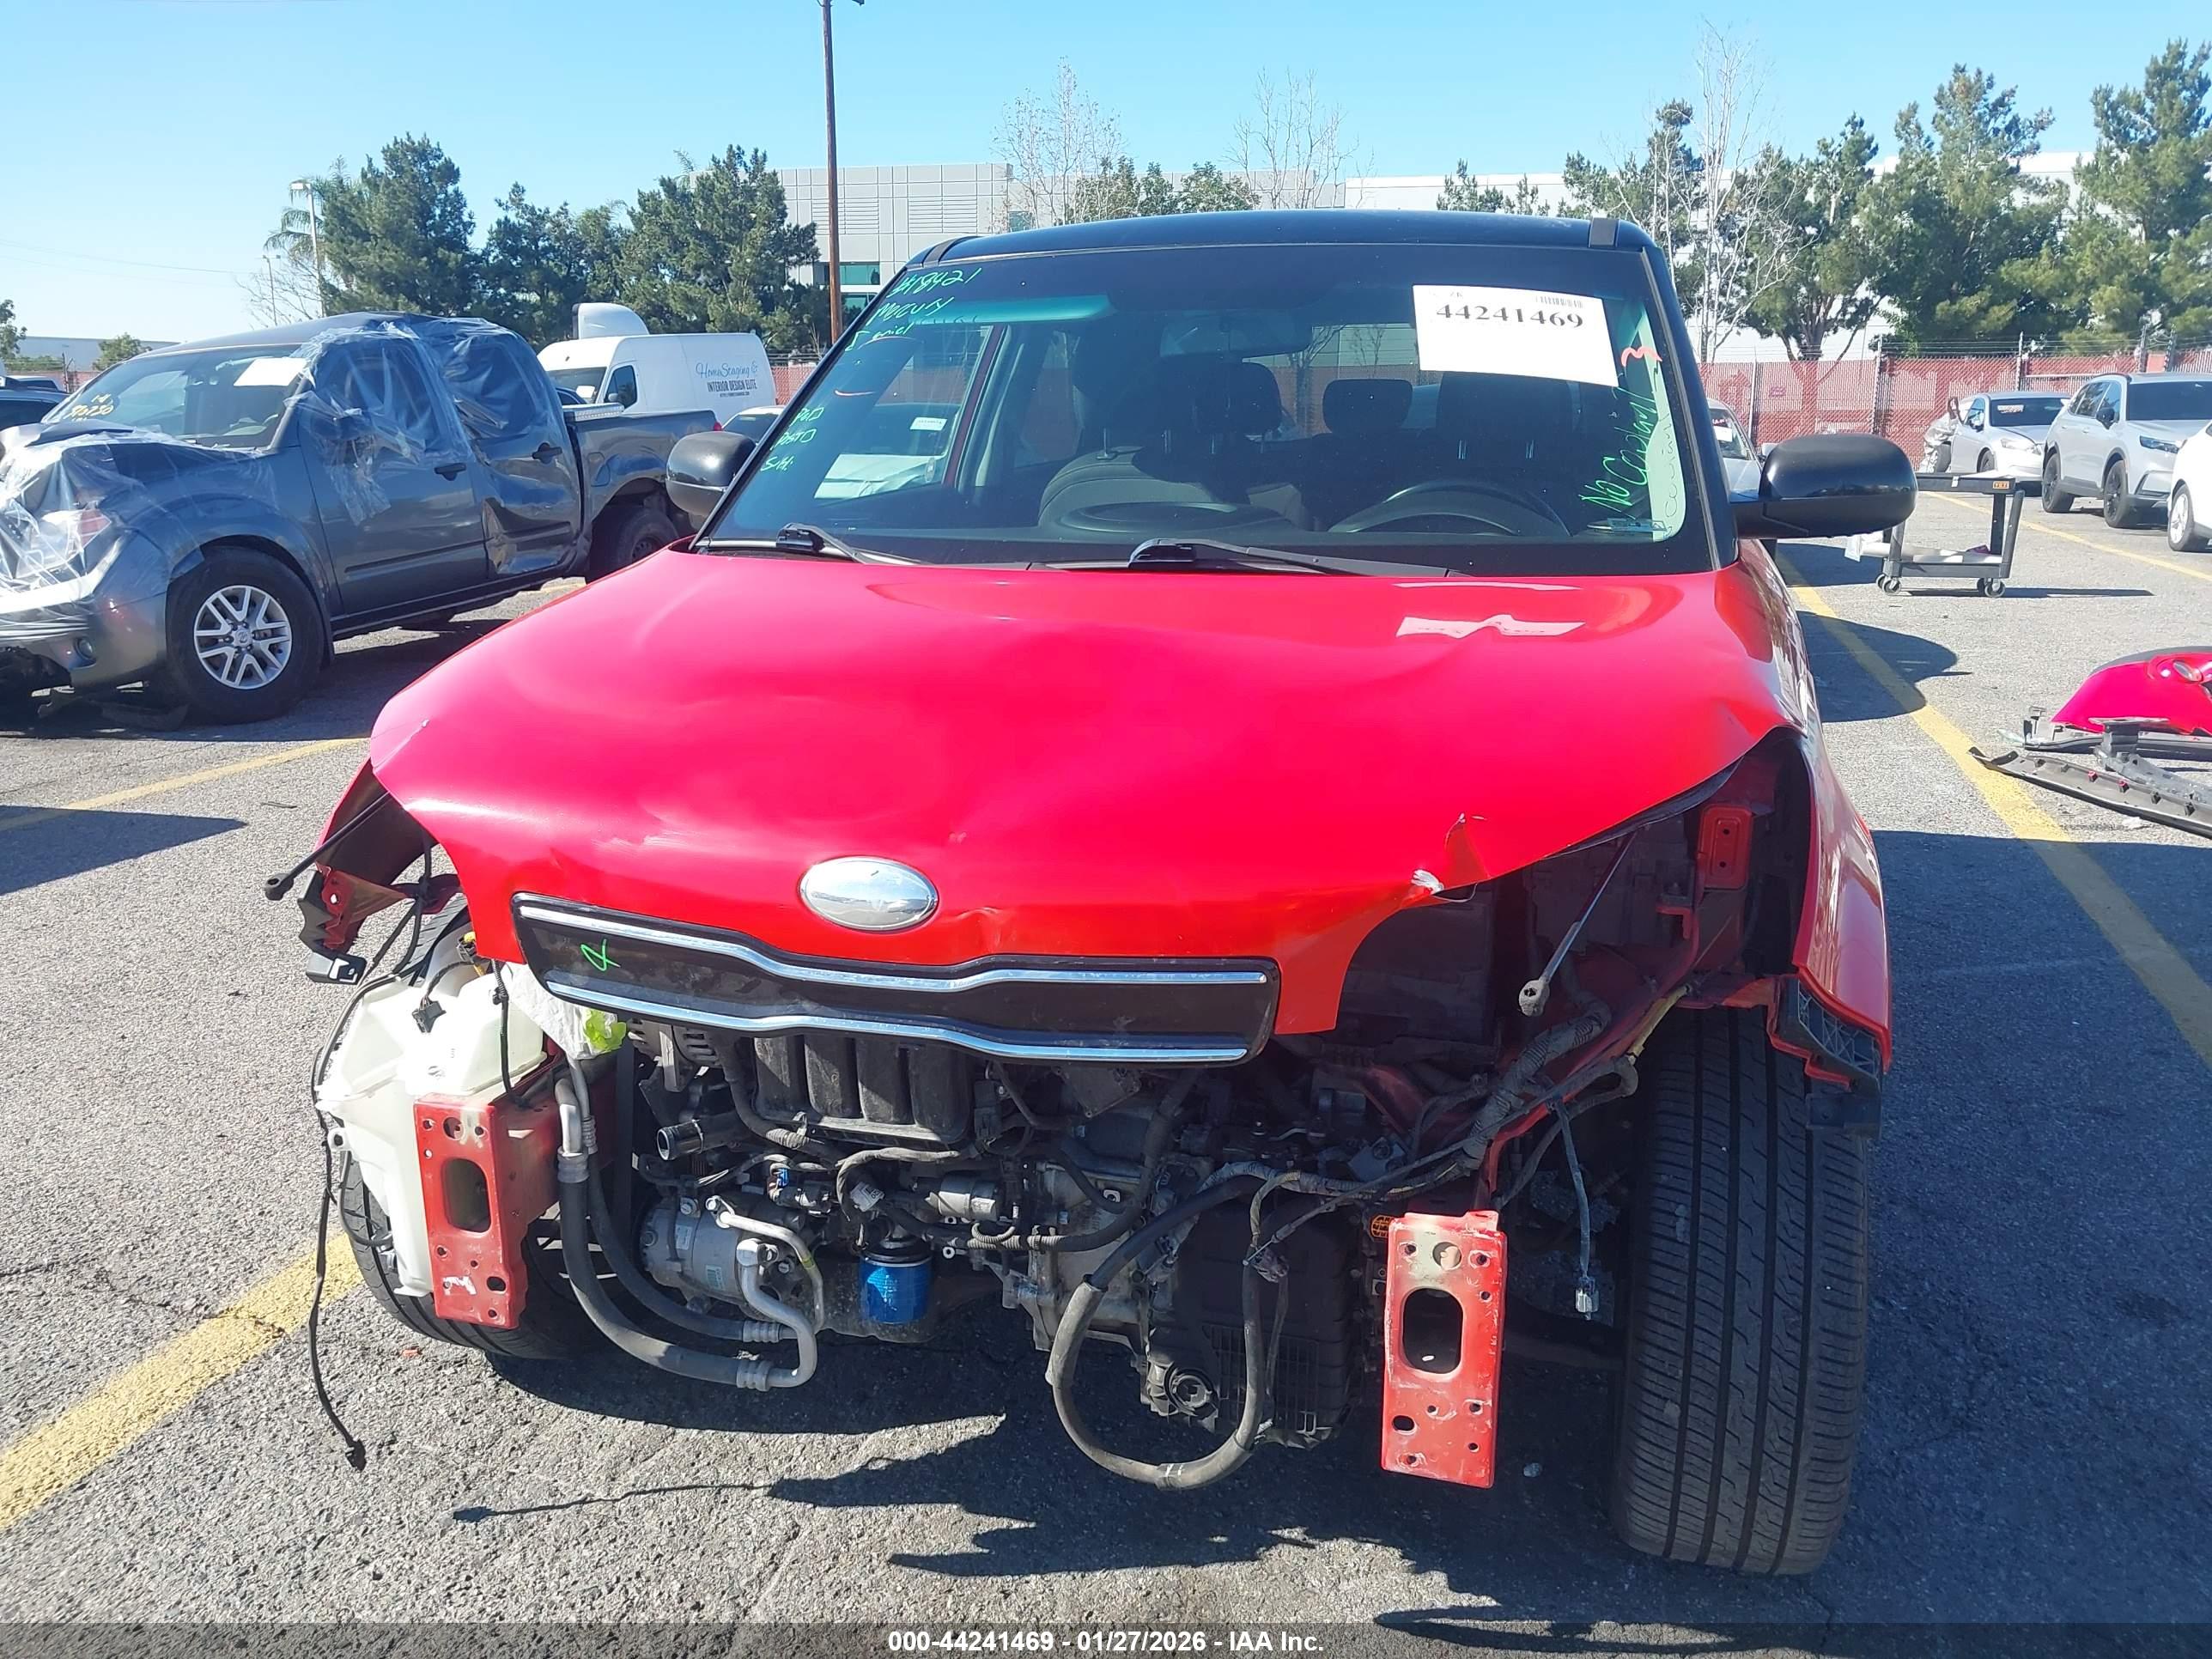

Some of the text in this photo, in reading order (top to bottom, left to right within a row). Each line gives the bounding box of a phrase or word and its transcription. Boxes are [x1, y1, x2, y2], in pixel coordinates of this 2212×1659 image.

[1436, 304, 1583, 328] 44241469
[708, 379, 757, 392] INTERIOR DESIGN ELITE
